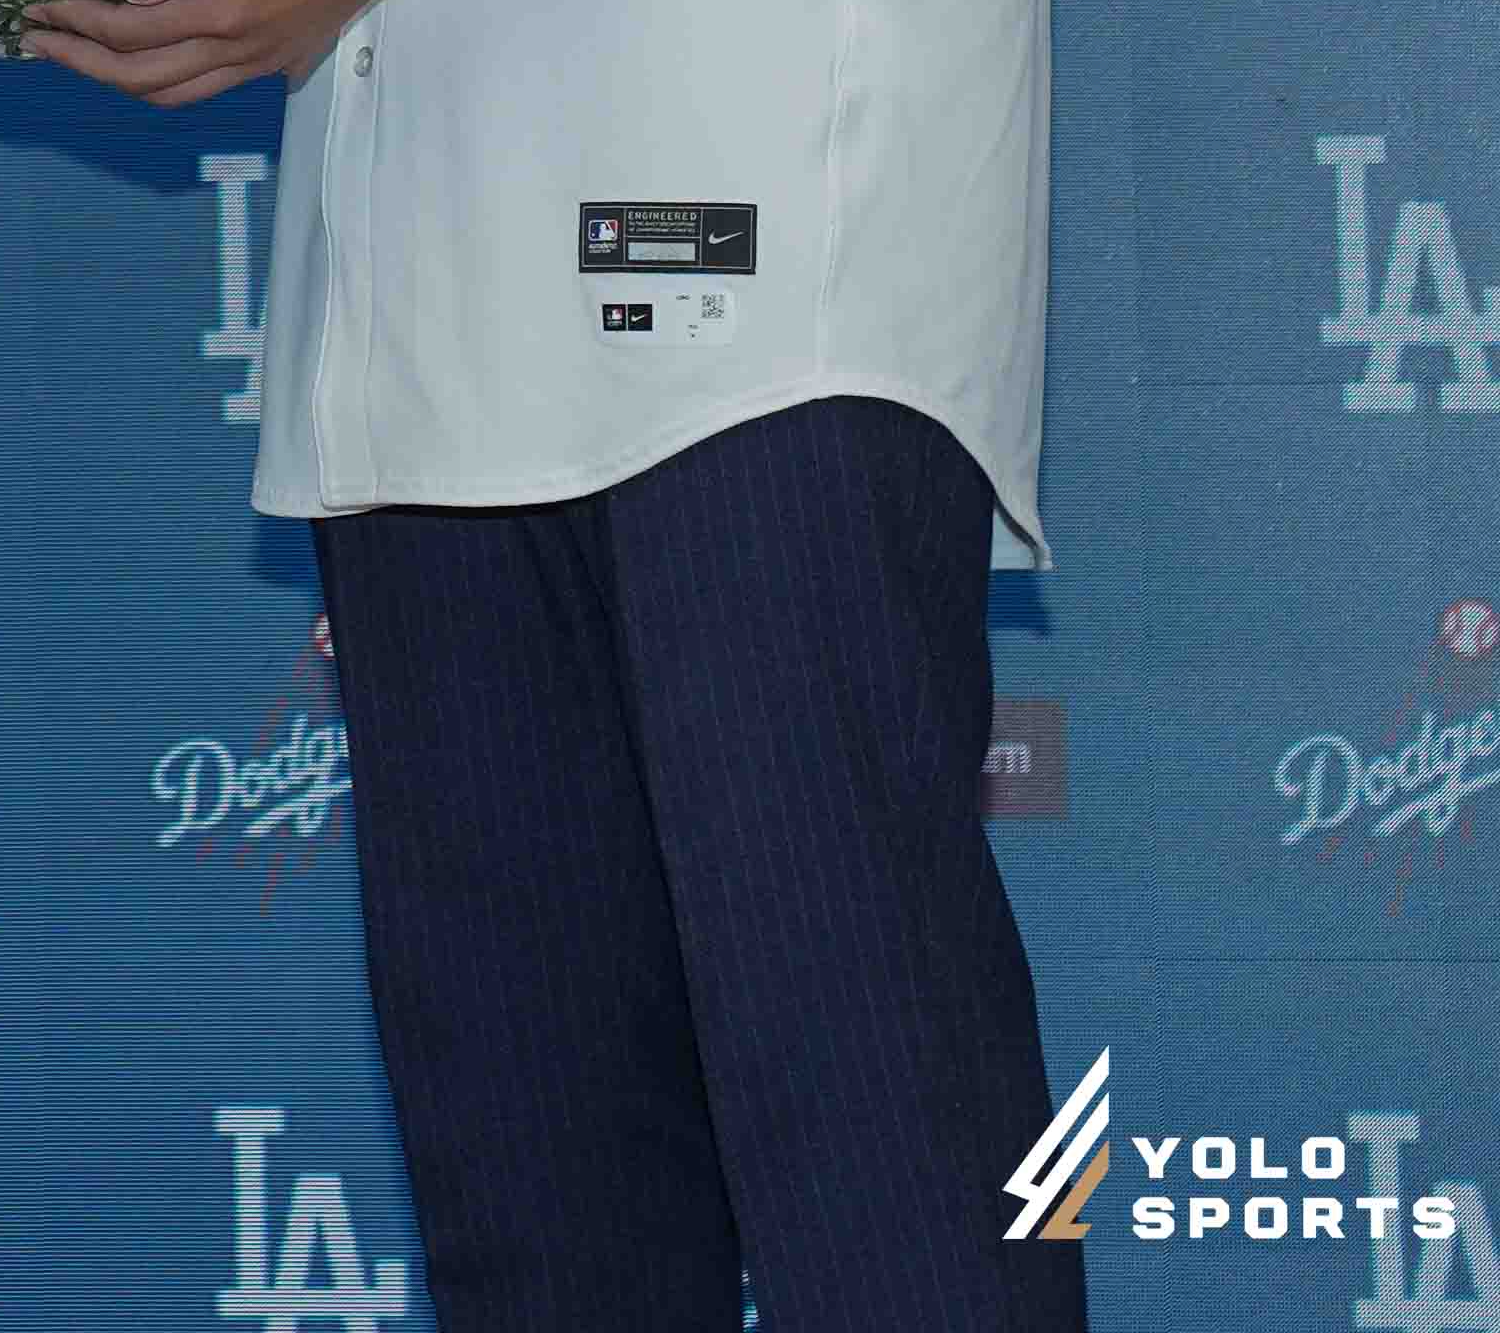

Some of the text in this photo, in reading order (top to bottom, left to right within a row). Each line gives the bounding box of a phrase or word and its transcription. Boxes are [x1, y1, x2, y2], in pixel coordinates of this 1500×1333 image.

[628, 211, 697, 220] ENGINEERED
[1314, 135, 1500, 414] LA
[154, 711, 353, 848] Dodg
[1275, 711, 1500, 845] Dodge
[213, 1109, 408, 1333] LA
